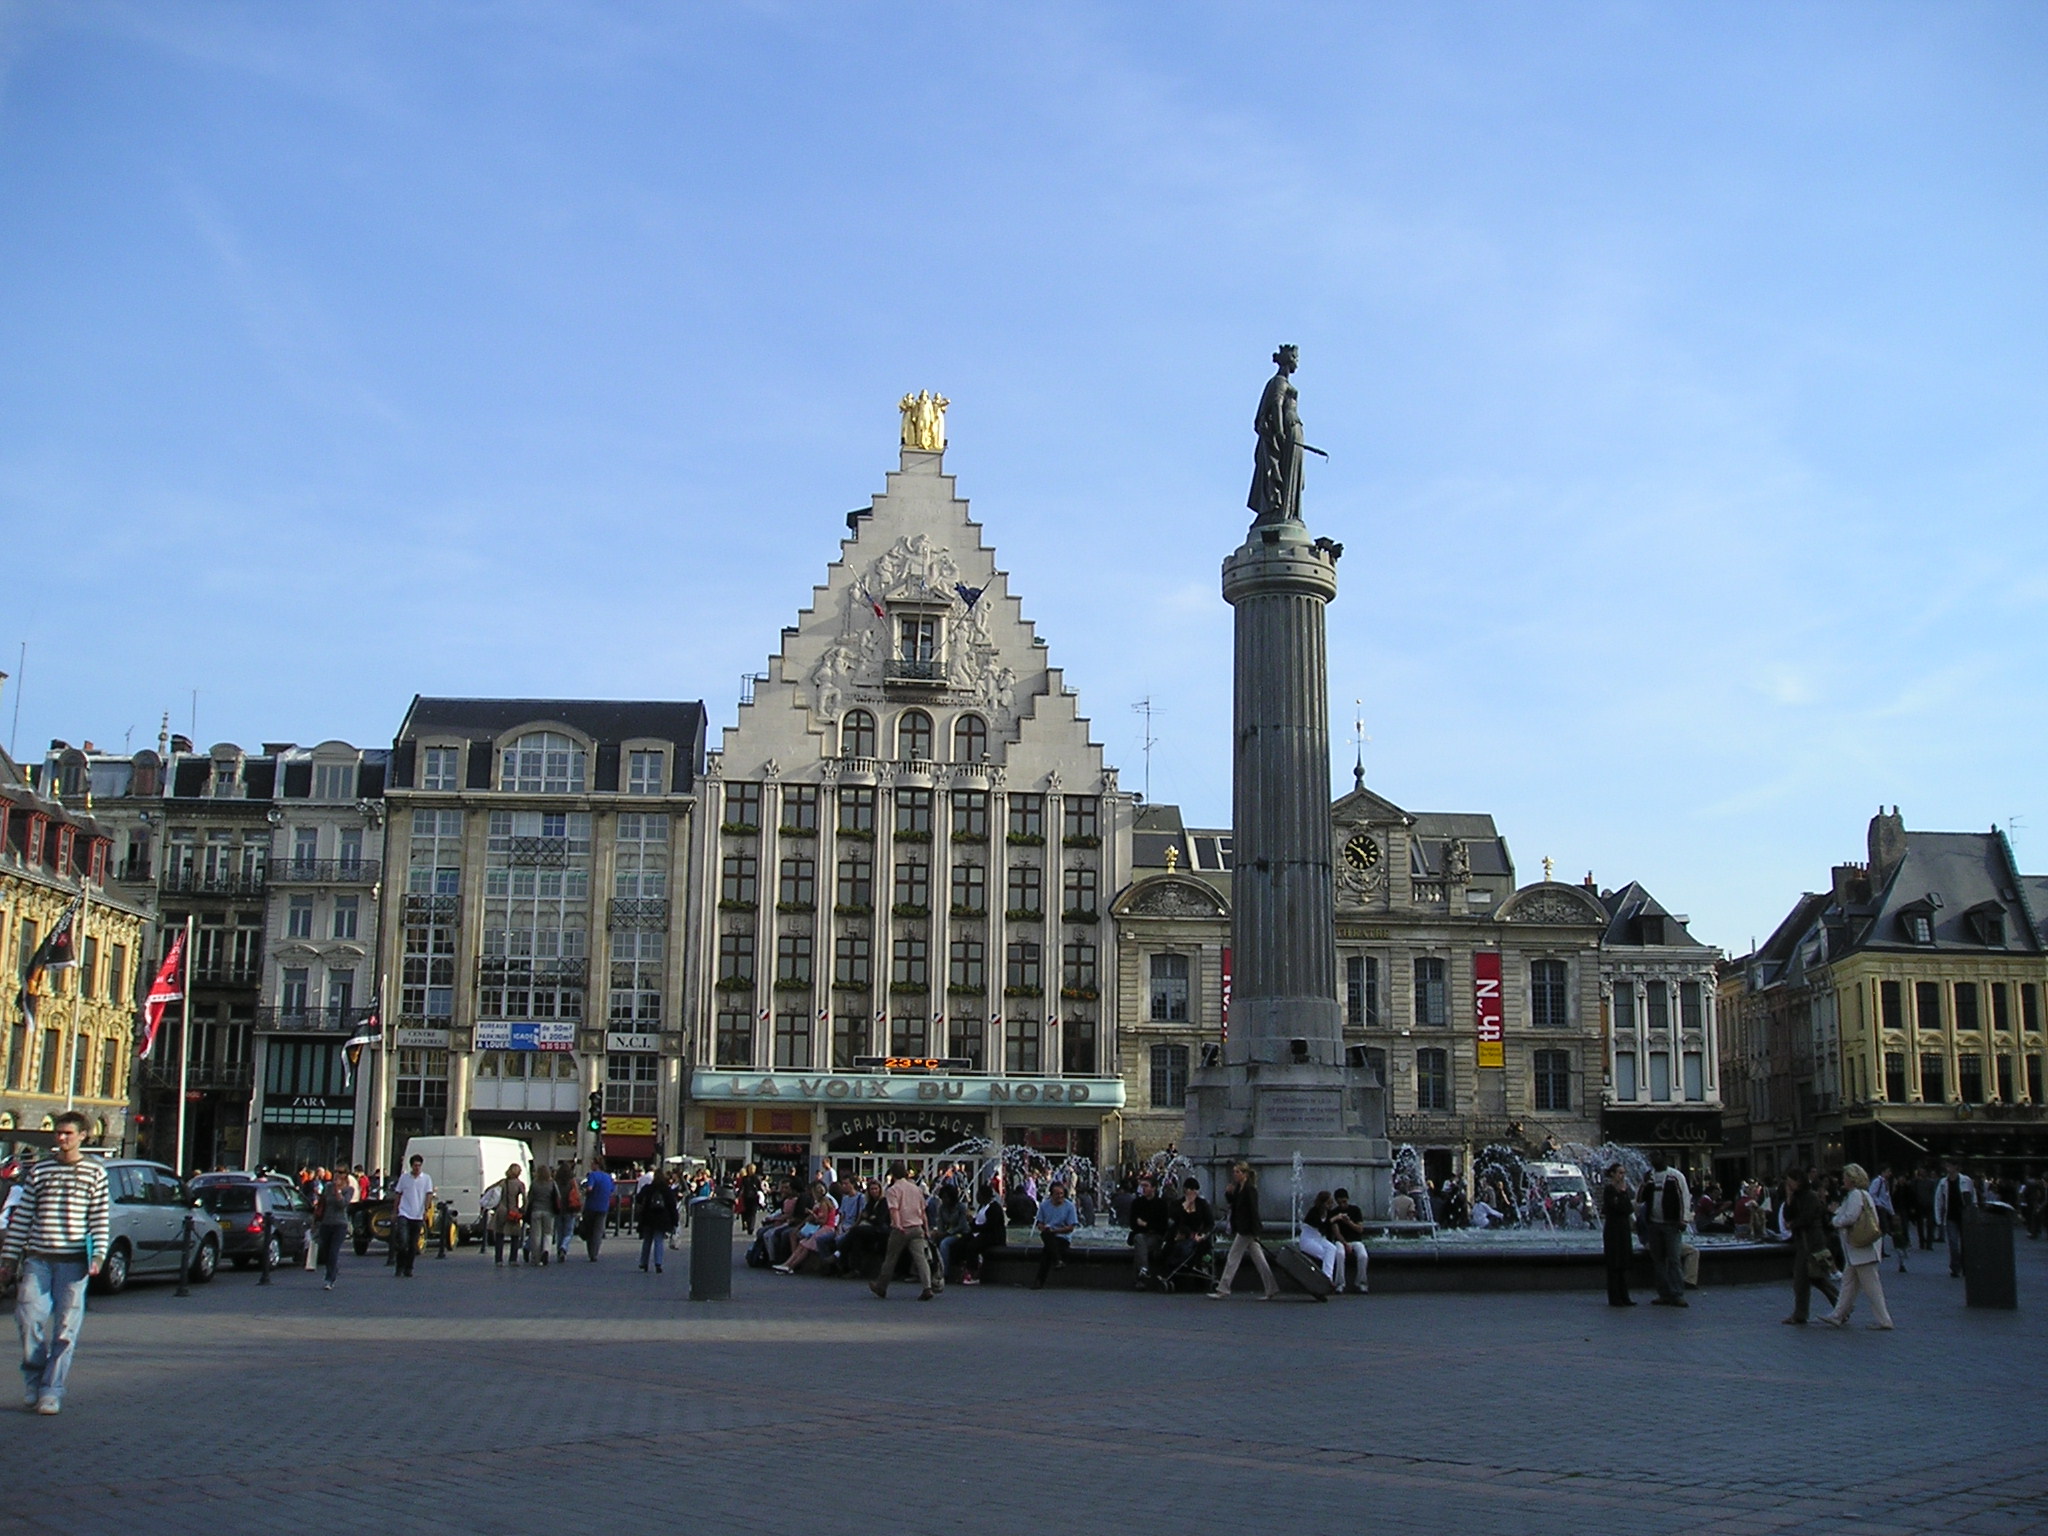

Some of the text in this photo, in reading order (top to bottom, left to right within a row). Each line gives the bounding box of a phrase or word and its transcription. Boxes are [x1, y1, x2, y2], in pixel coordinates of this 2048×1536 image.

[485, 1041, 510, 1049] LOUER
[616, 1036, 651, 1048] N.C.I.
[730, 1077, 1090, 1102] LA VOIX DU NORD
[292, 1097, 326, 1107] ZARA
[506, 1121, 541, 1131] ZARA
[917, 1112, 974, 1137] PLACE
[876, 1123, 937, 1143] fnac
